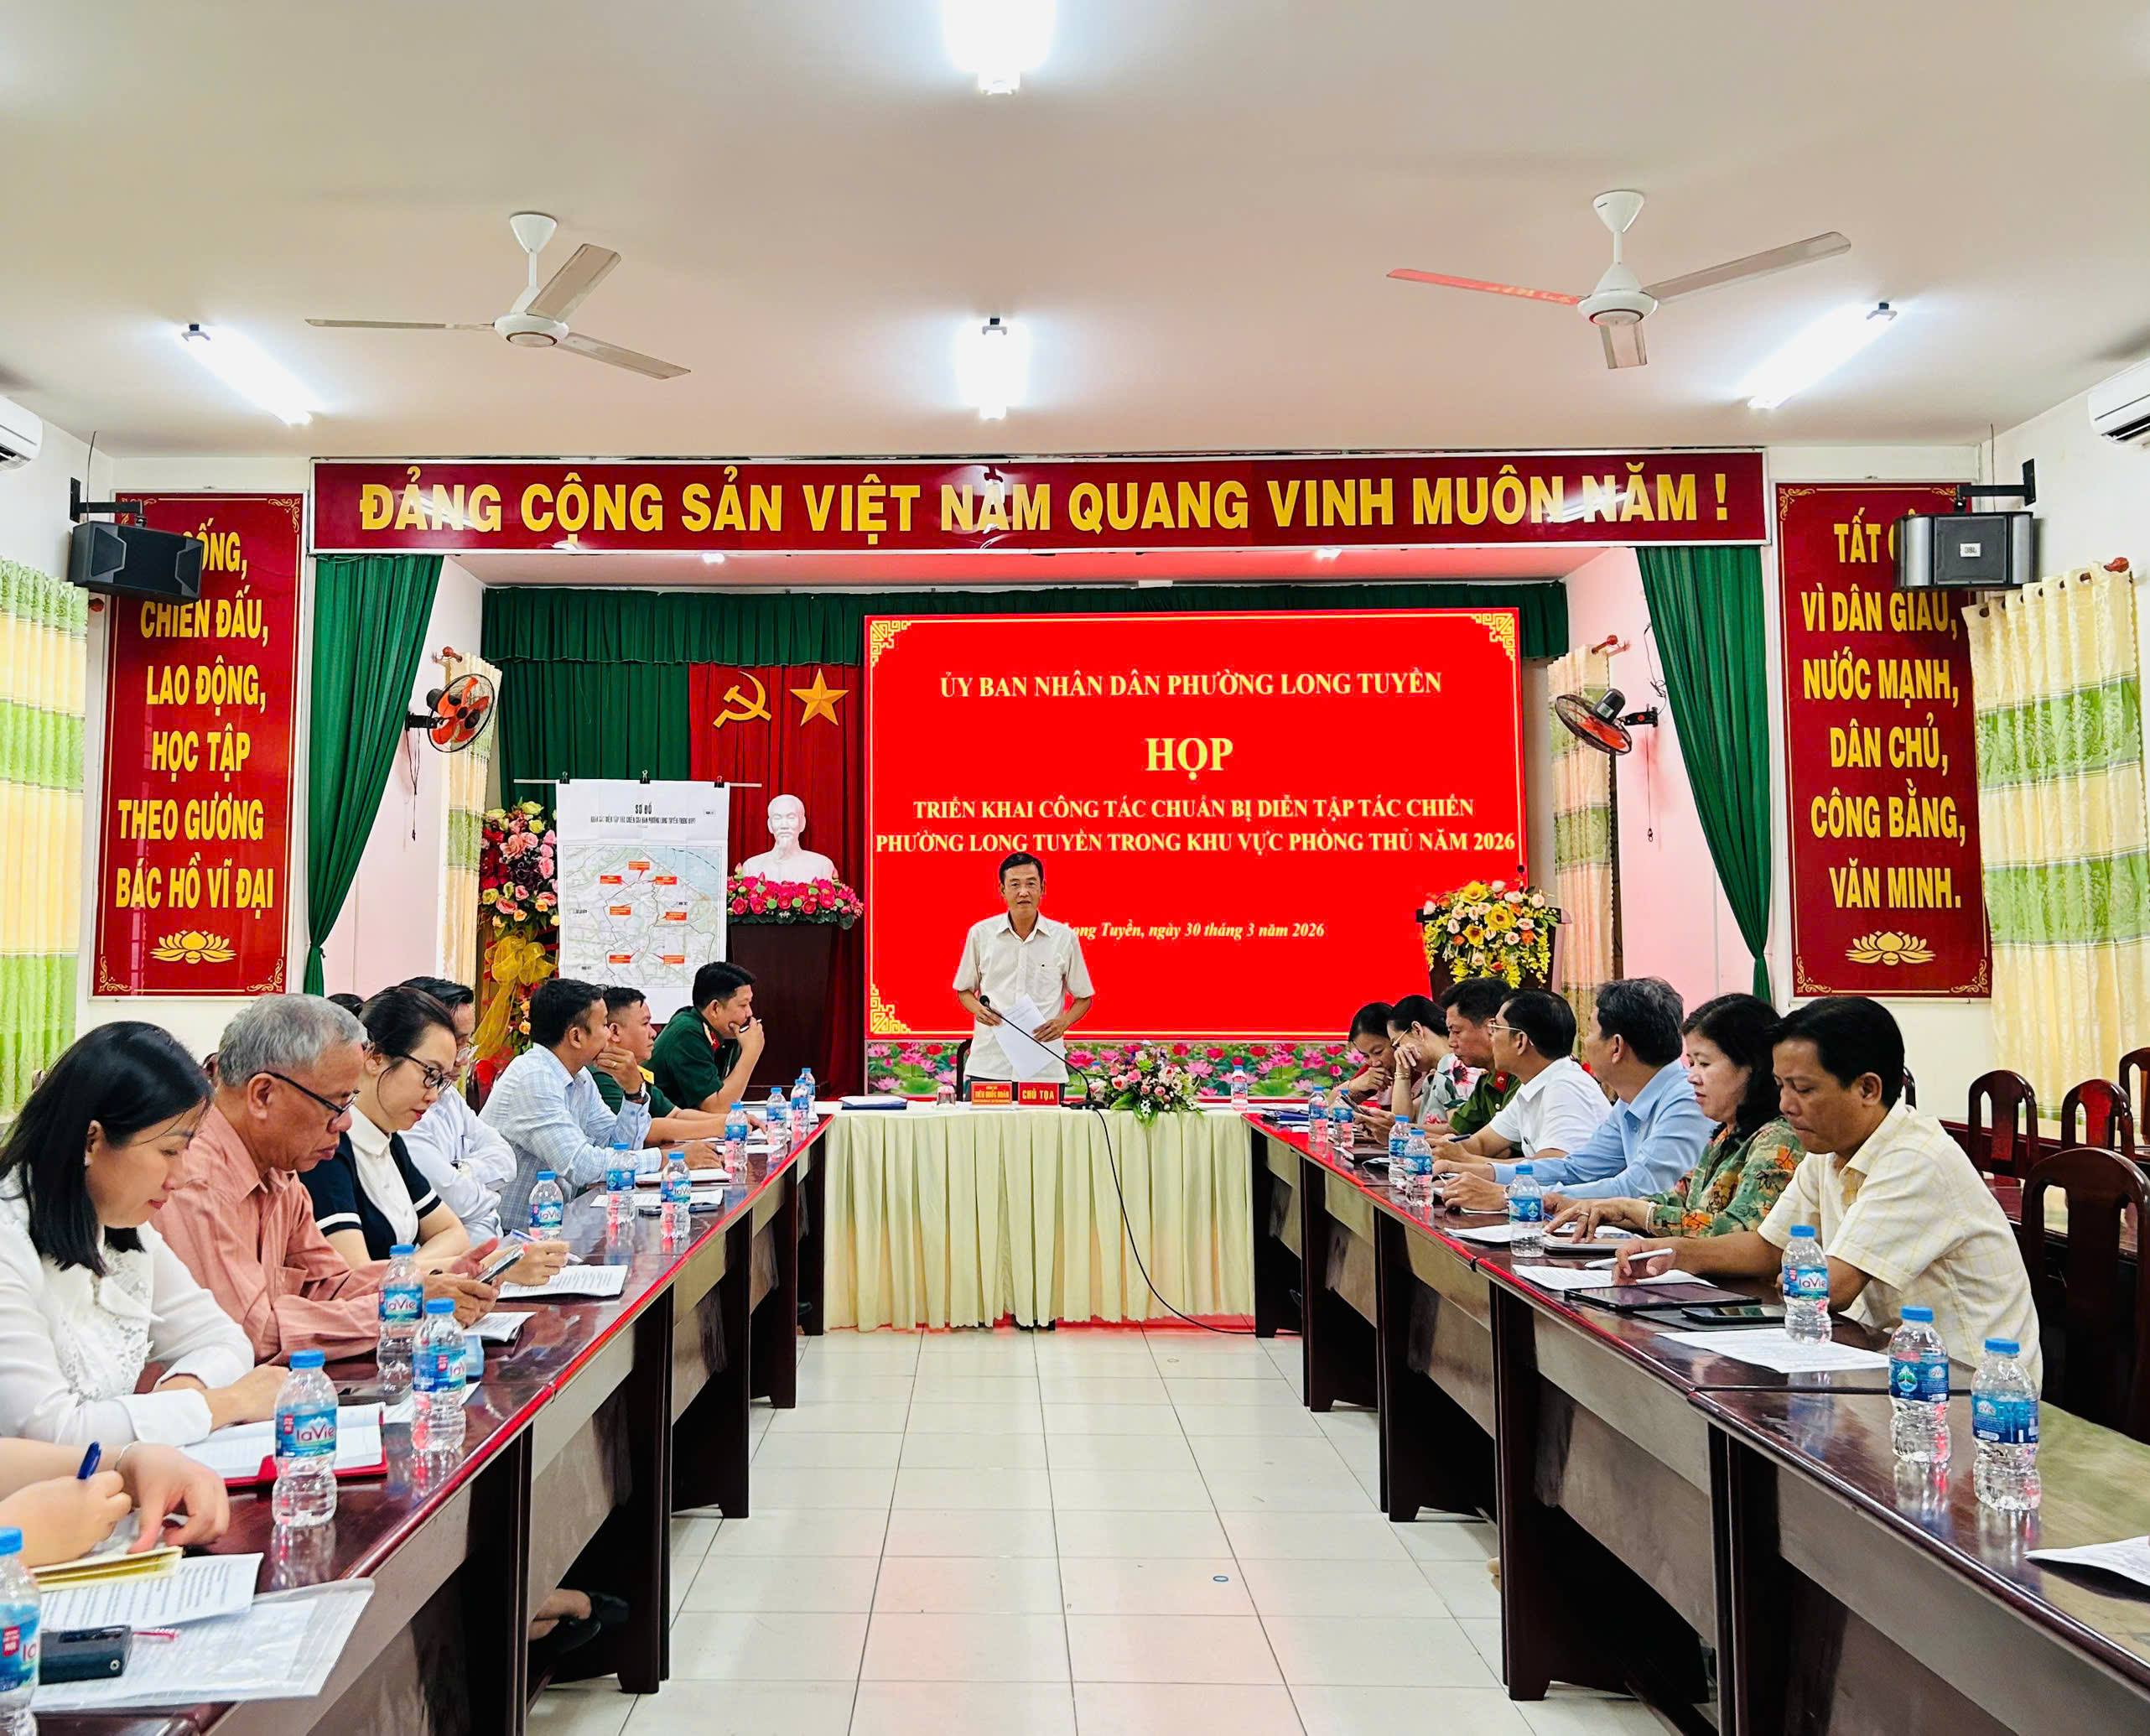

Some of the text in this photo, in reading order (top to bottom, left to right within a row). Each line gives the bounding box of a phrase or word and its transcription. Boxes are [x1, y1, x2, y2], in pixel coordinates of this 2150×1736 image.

[360, 466, 501, 531] ĐẢNG
[521, 473, 662, 543] CỘNG
[683, 466, 782, 531] SẢN
[803, 474, 920, 544] VIỆT
[942, 484, 1050, 531] NAM
[1069, 481, 1248, 533] QUANG
[1268, 479, 1393, 527] VINH
[1413, 465, 1563, 525] MUÔN
[1583, 463, 1696, 521] NĂM
[184, 517, 247, 580] ỐNG,
[1834, 509, 1880, 562] TẤT
[216, 588, 267, 643] ĐẤU,
[1801, 584, 1825, 631] VÌ
[1832, 584, 1882, 631] DÂN
[147, 657, 265, 716] LAO ĐỘNG,
[941, 668, 1441, 697] ỦY BAN NHÂN DÂN PHƯỜNG LONG TUYỀN
[1804, 647, 1958, 708] NƯỚC MẠNH,
[152, 723, 250, 782] HỌC TẬP
[1146, 738, 1233, 780] HỌP
[1831, 713, 1948, 777] DÂN CHỦ,
[118, 794, 263, 840] THEO GƯƠNG
[914, 794, 1472, 822] TRIỂN KHAI CÔNG TÁC CHUẨN BỊ DIỄN TẬP TÁC CHIẾN
[1811, 779, 1965, 845] CÔNG BẰNG,
[877, 829, 1514, 855] PHƯỜNG LONG TUYỀN TRONG KHU VỰC PHÒNG THỦ NĂM 2026
[117, 853, 273, 919] BÁC HỒ VĨ ĐẠI
[1830, 860, 1960, 907] VĂN MINH.
[1072, 926, 1097, 939] ong
[1149, 924, 1181, 939] ngày
[1186, 923, 1201, 936] 30
[1204, 923, 1243, 939] tháng
[1247, 923, 1254, 936] 3
[1259, 924, 1288, 936] năm
[1292, 923, 1324, 937] 2026
[1022, 1088, 1054, 1100] CHỦ TỌA
